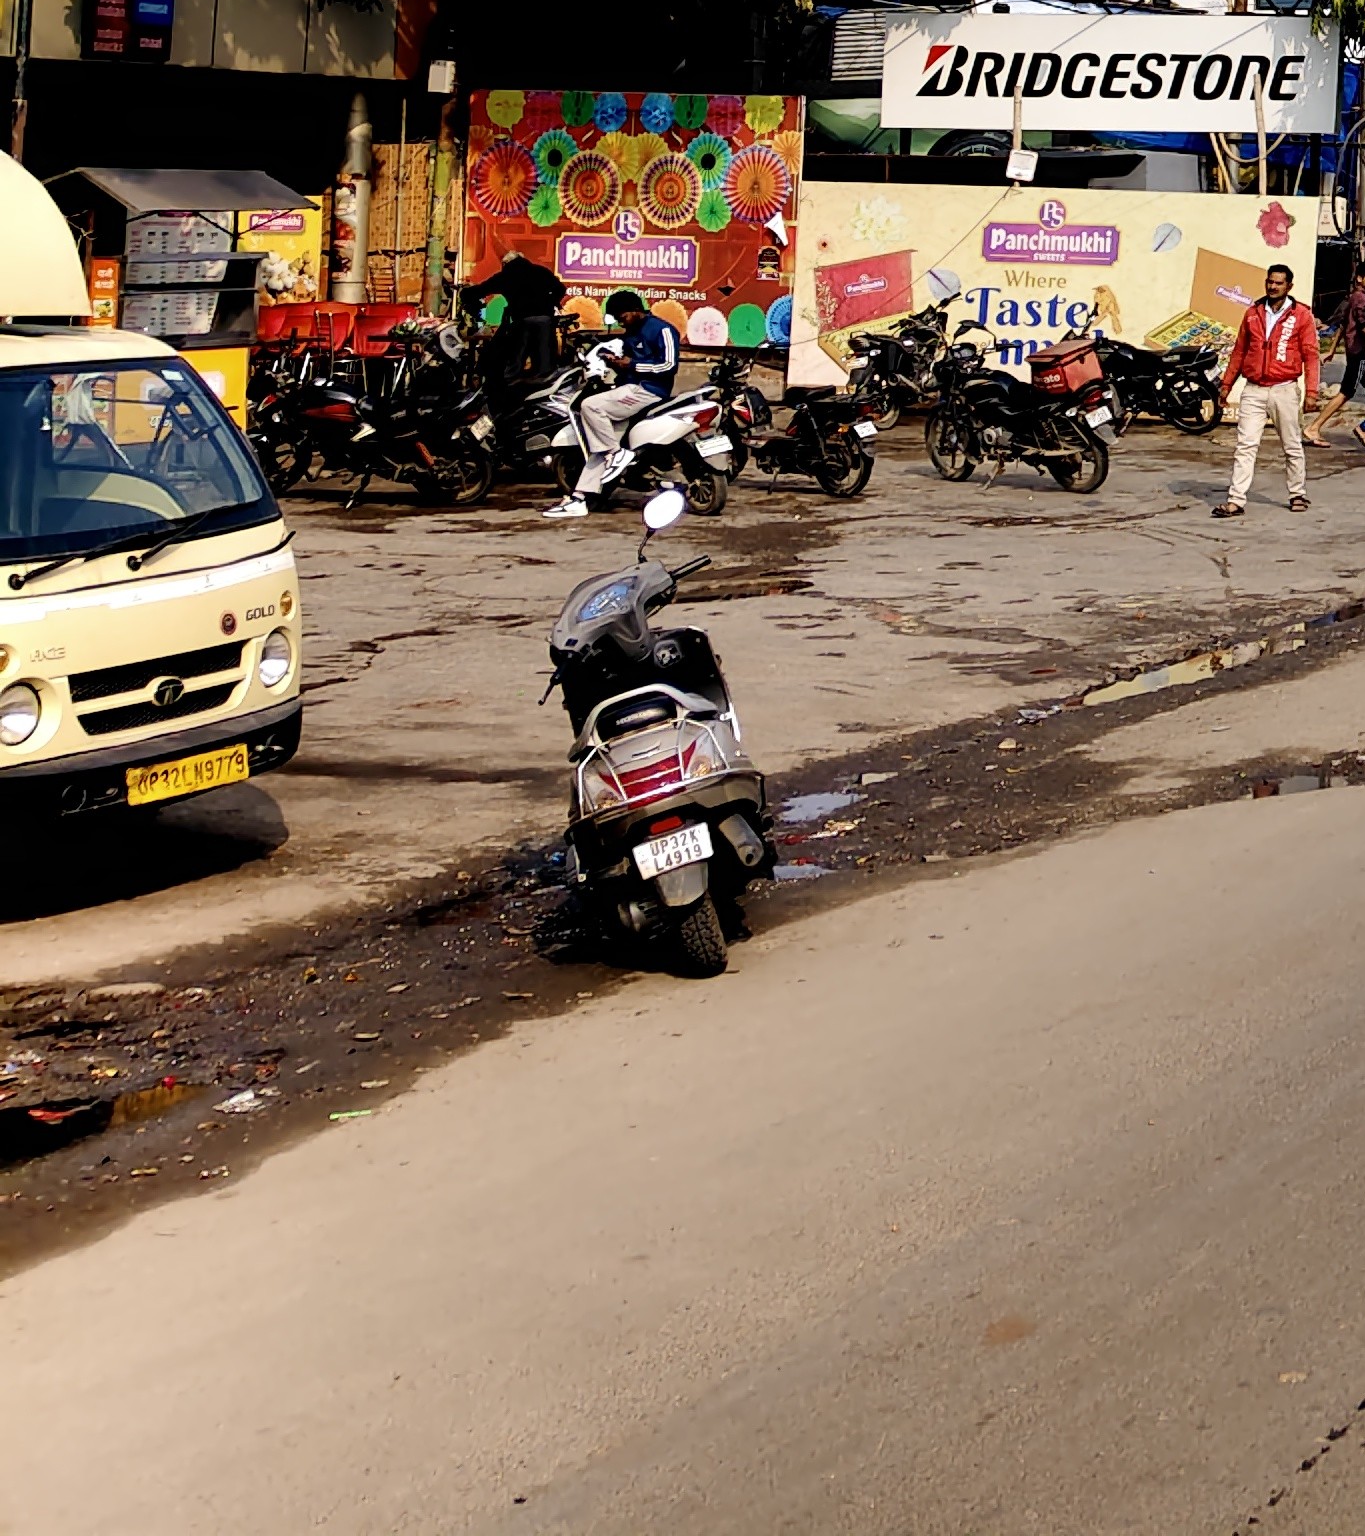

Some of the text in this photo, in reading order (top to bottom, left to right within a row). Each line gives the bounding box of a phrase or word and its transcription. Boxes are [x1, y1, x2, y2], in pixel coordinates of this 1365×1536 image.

[916, 44, 1304, 101] BRIDGESTONE
[990, 228, 1113, 254] Panchmukhi
[565, 241, 689, 270] Panchmukhi
[1032, 253, 1066, 262] SWEETS
[609, 269, 643, 279] SWEETS
[1005, 270, 1067, 289] Where
[669, 289, 707, 301] Snacks
[965, 286, 1089, 328] Taste
[1276, 316, 1297, 362] zomato
[246, 605, 275, 621] GOLD
[650, 833, 699, 857] UP32K
[654, 845, 702, 872] L4919
